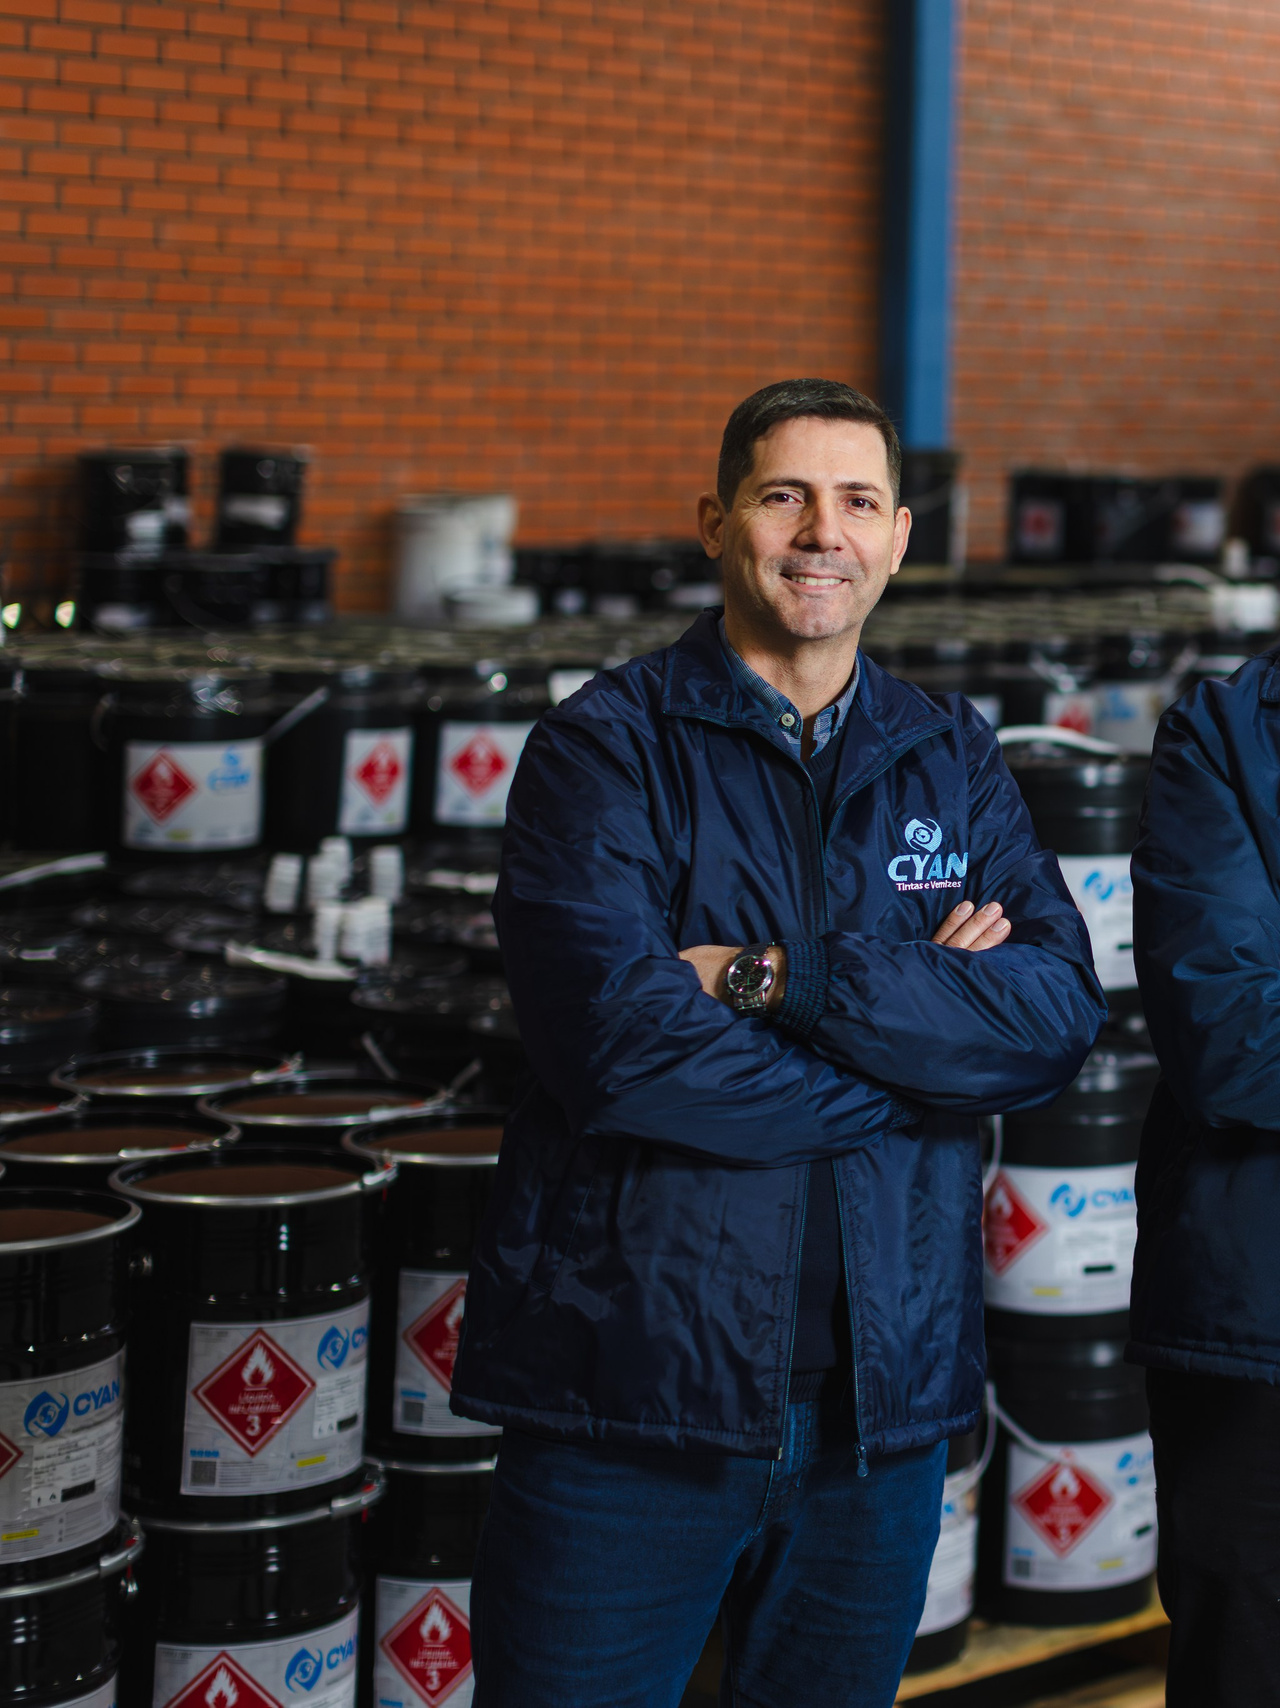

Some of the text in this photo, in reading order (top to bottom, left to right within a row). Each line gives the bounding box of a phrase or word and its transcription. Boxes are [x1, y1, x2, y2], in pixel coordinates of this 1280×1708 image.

[887, 852, 968, 882] CYAN
[896, 882, 923, 891] Tintas
[930, 879, 962, 890] Vernizes
[73, 1377, 120, 1416] CYAN
[245, 1414, 262, 1437] 3
[426, 1669, 441, 1691] 3
